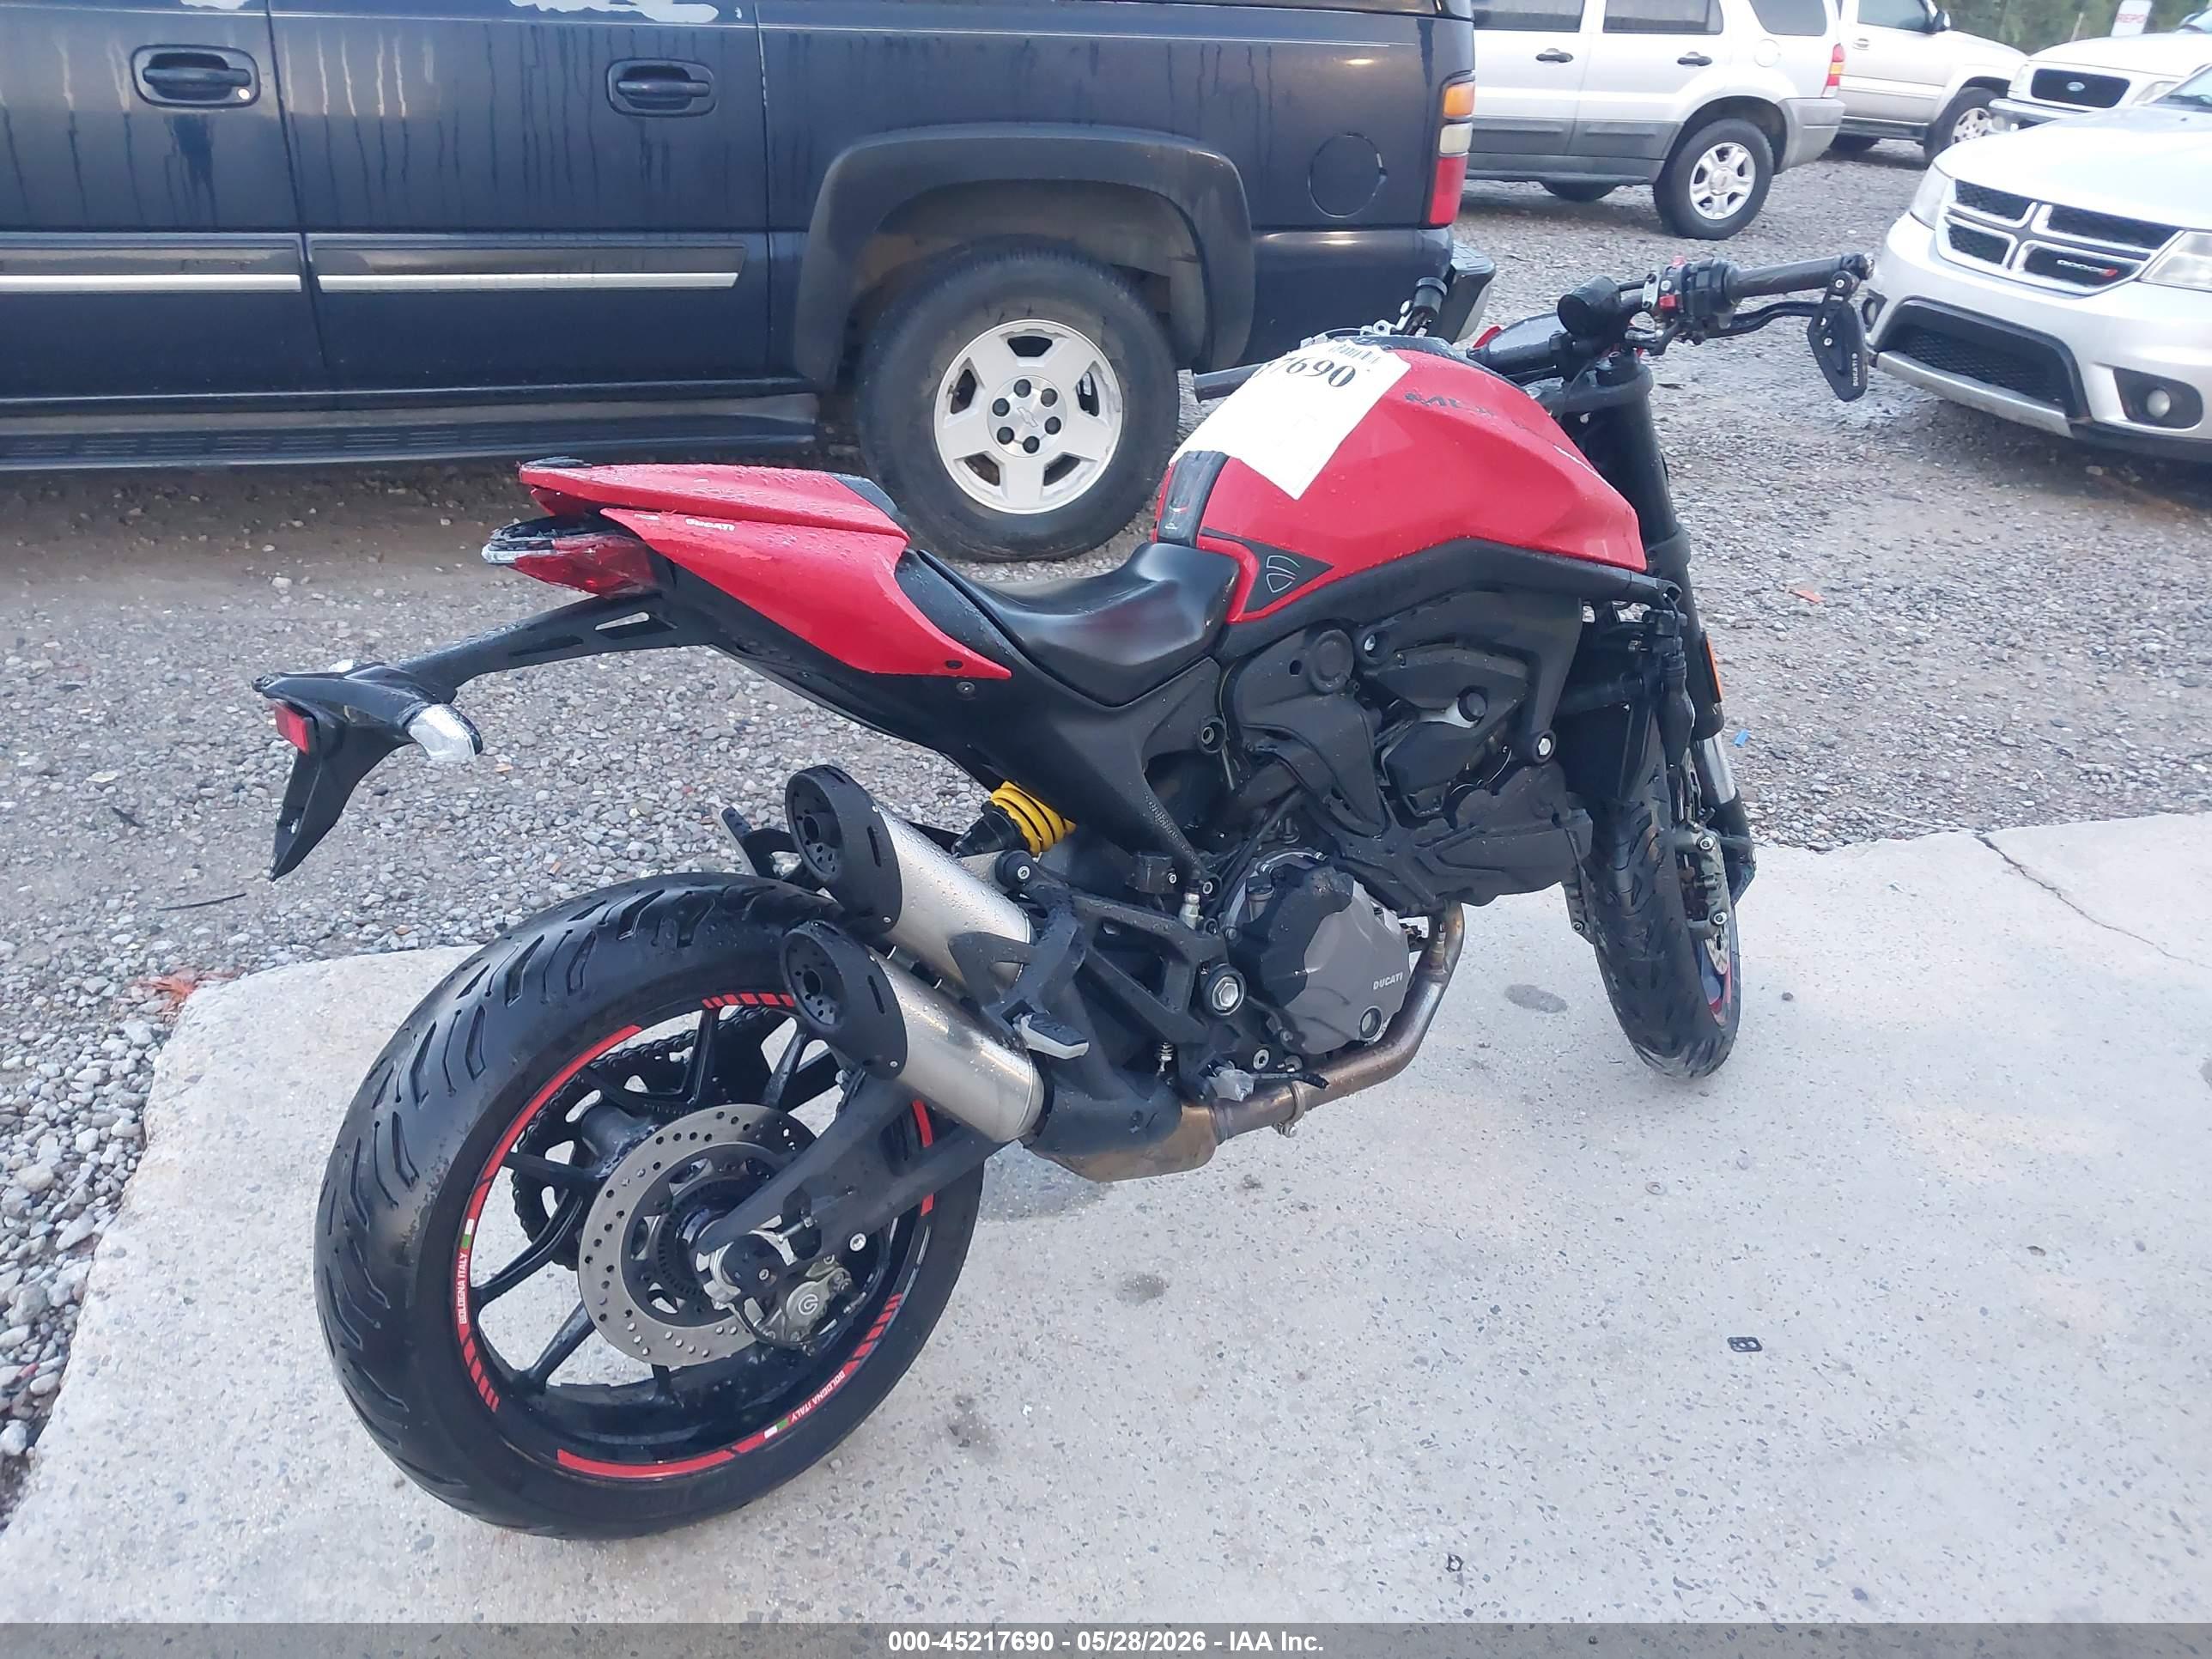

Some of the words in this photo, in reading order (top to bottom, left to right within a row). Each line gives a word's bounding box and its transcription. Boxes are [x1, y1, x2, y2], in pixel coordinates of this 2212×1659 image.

[1373, 971, 1403, 990] DUCATI
[458, 1252, 468, 1279] ITALY
[457, 1281, 468, 1324] BOLOGNA
[811, 1370, 846, 1405] BOLOGNA
[791, 1401, 812, 1423] ITALY
